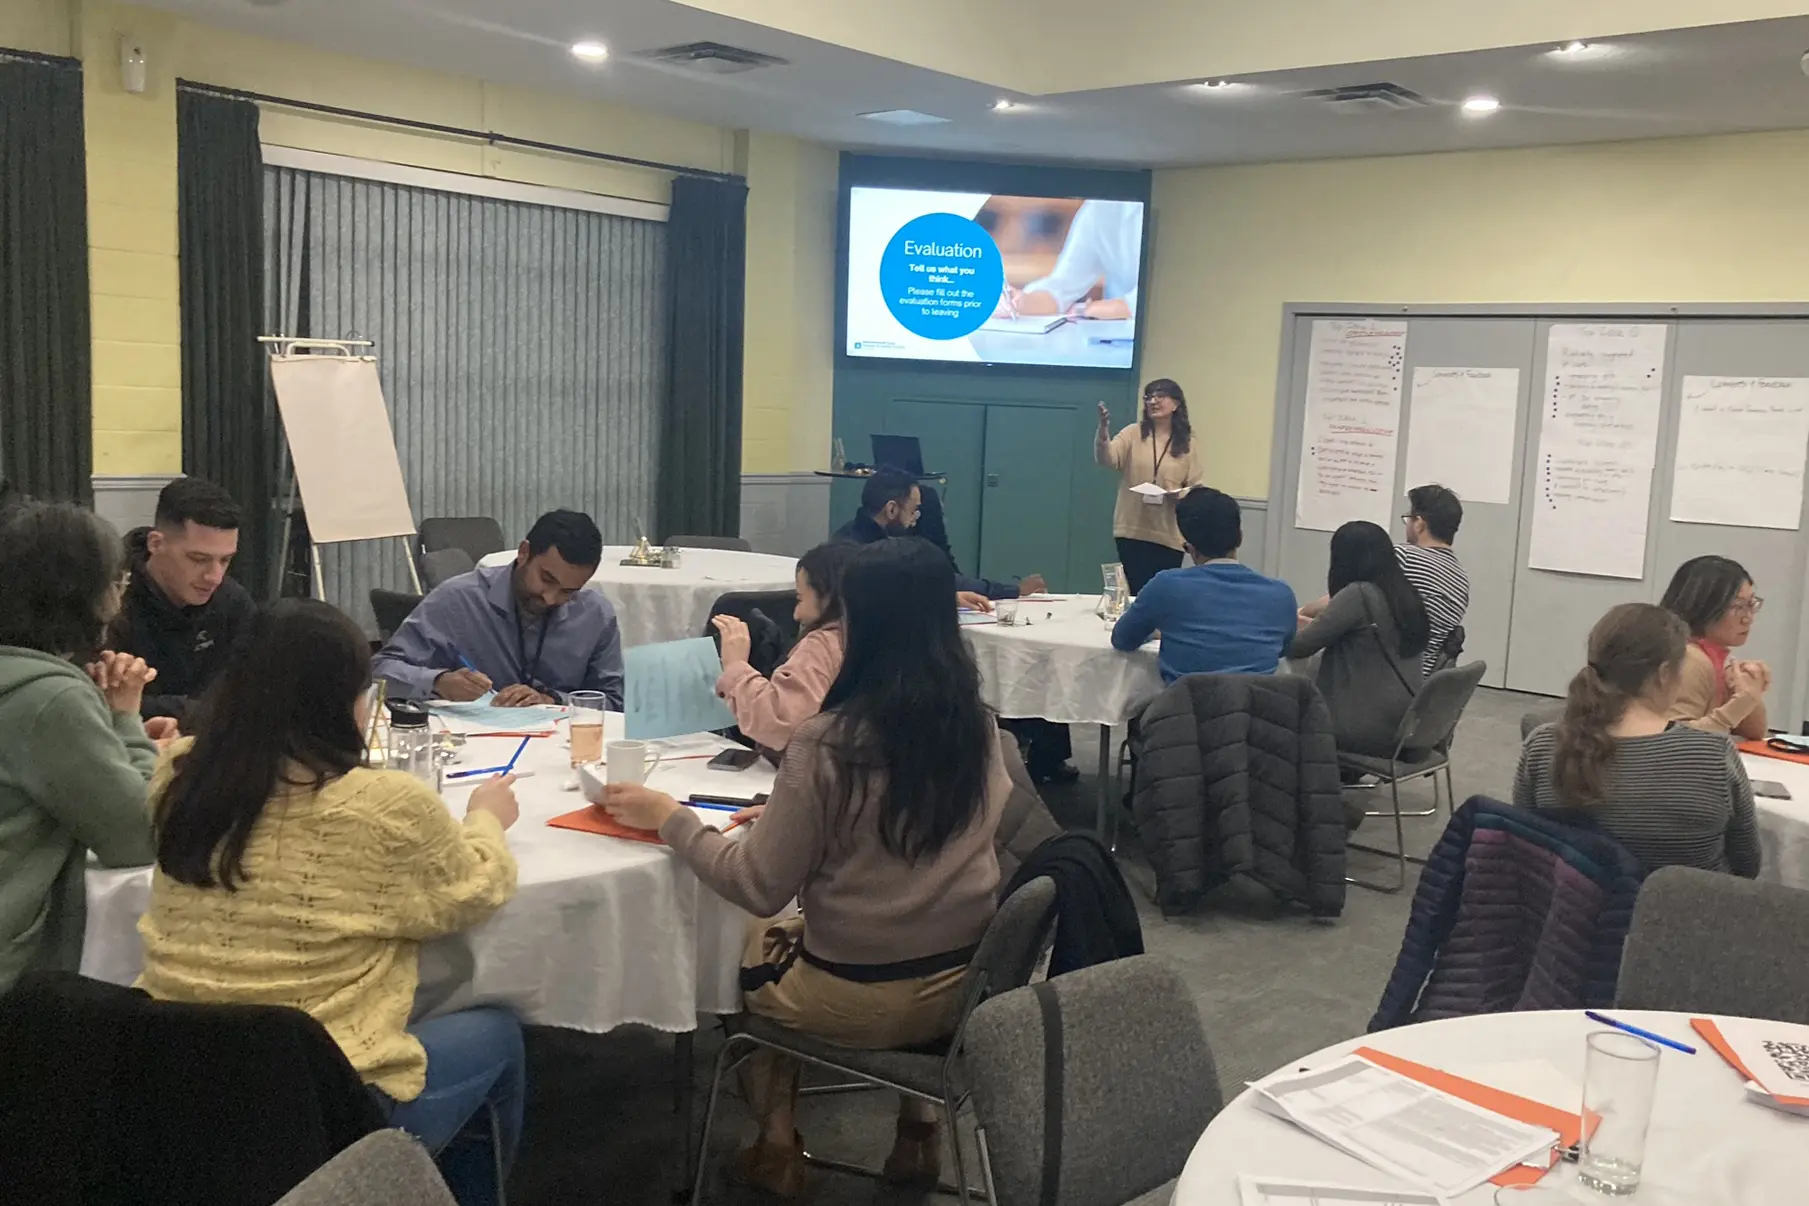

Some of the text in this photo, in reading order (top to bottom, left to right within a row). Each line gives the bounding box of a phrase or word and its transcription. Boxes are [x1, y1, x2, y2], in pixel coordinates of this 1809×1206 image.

[905, 240, 982, 258] Evaluation
[909, 264, 925, 272] Tell
[938, 266, 958, 274] what
[959, 268, 975, 276] you
[907, 287, 975, 298] Please fill out the
[899, 297, 982, 308] evaluation forms prior
[921, 307, 959, 318] to leaving
